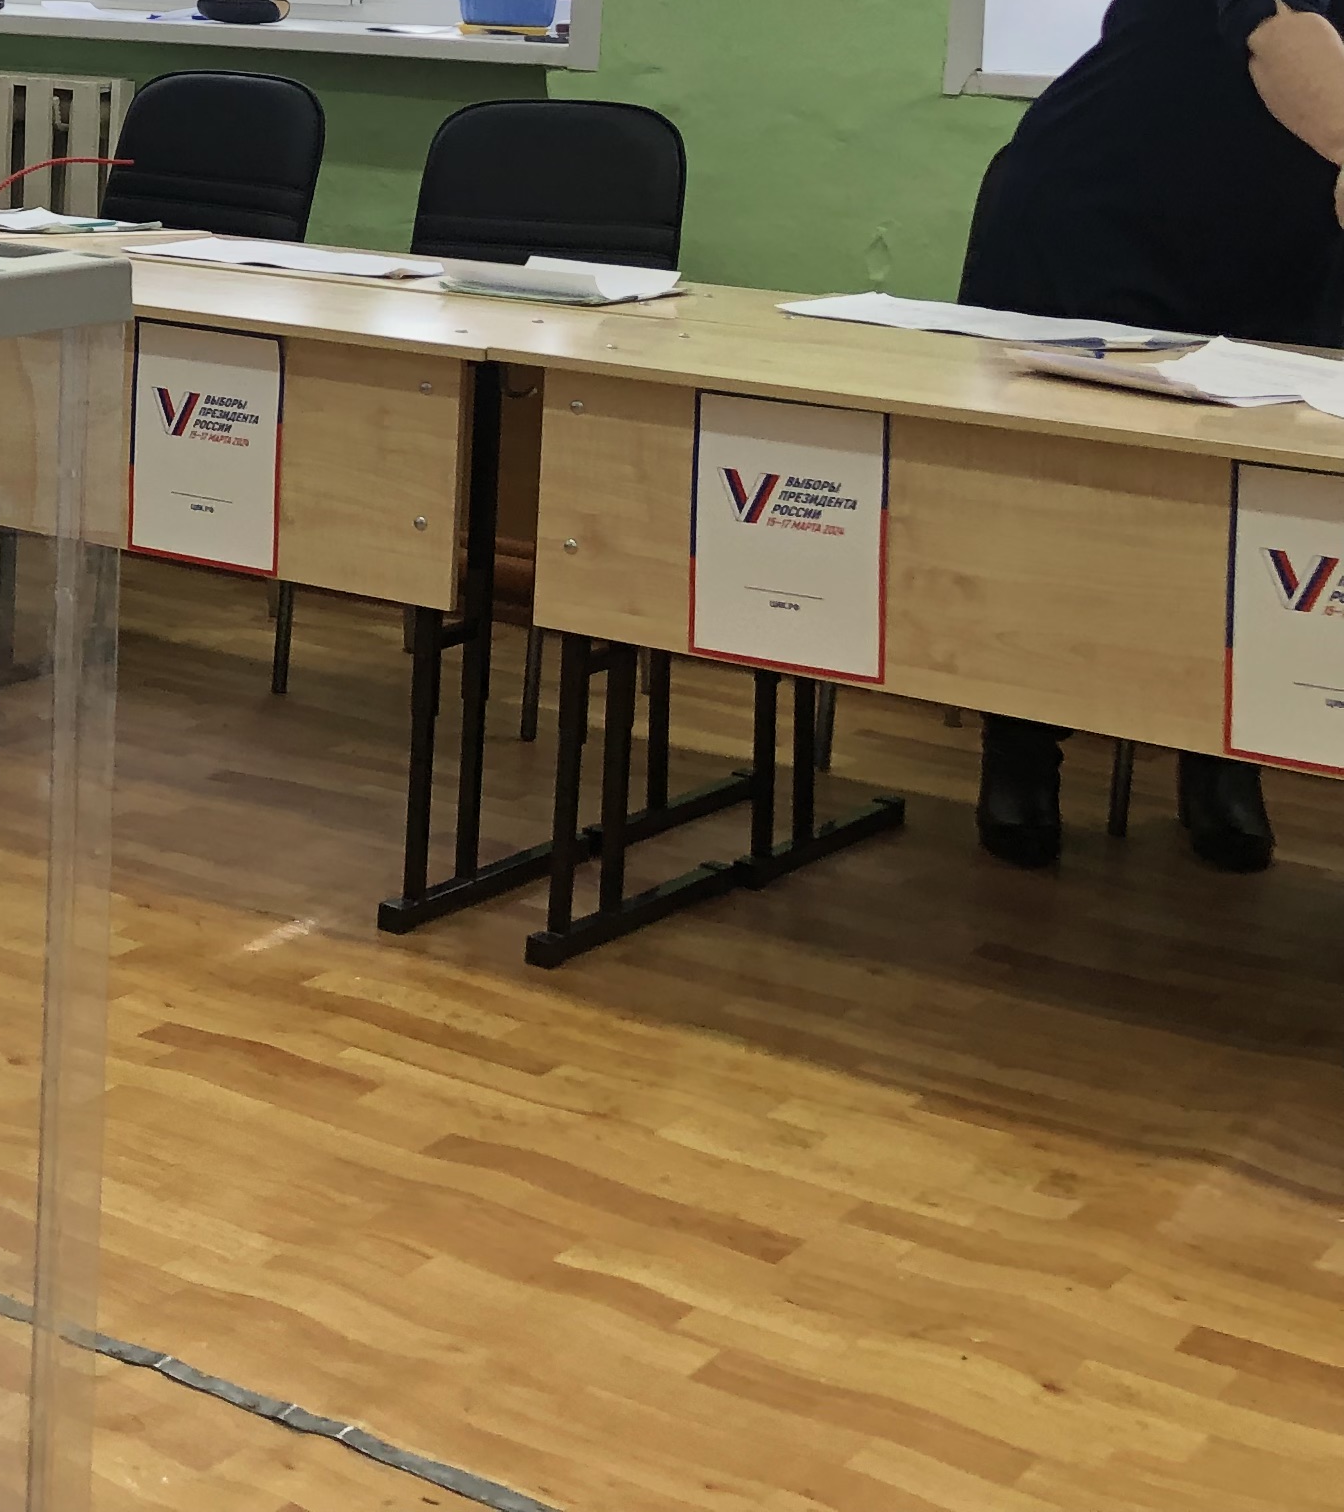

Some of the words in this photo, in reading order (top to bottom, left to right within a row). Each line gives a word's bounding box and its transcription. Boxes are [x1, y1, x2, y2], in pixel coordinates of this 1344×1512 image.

[204, 394, 248, 410] ВЫБОРЫ
[198, 407, 260, 425] ПРЕЗИДЕНТА
[193, 419, 233, 434] РОССИИ
[784, 476, 842, 494] ВЫБОРЫ
[778, 490, 858, 511] ПРЕЗИДЕНТА
[771, 504, 823, 520] РОССИИ
